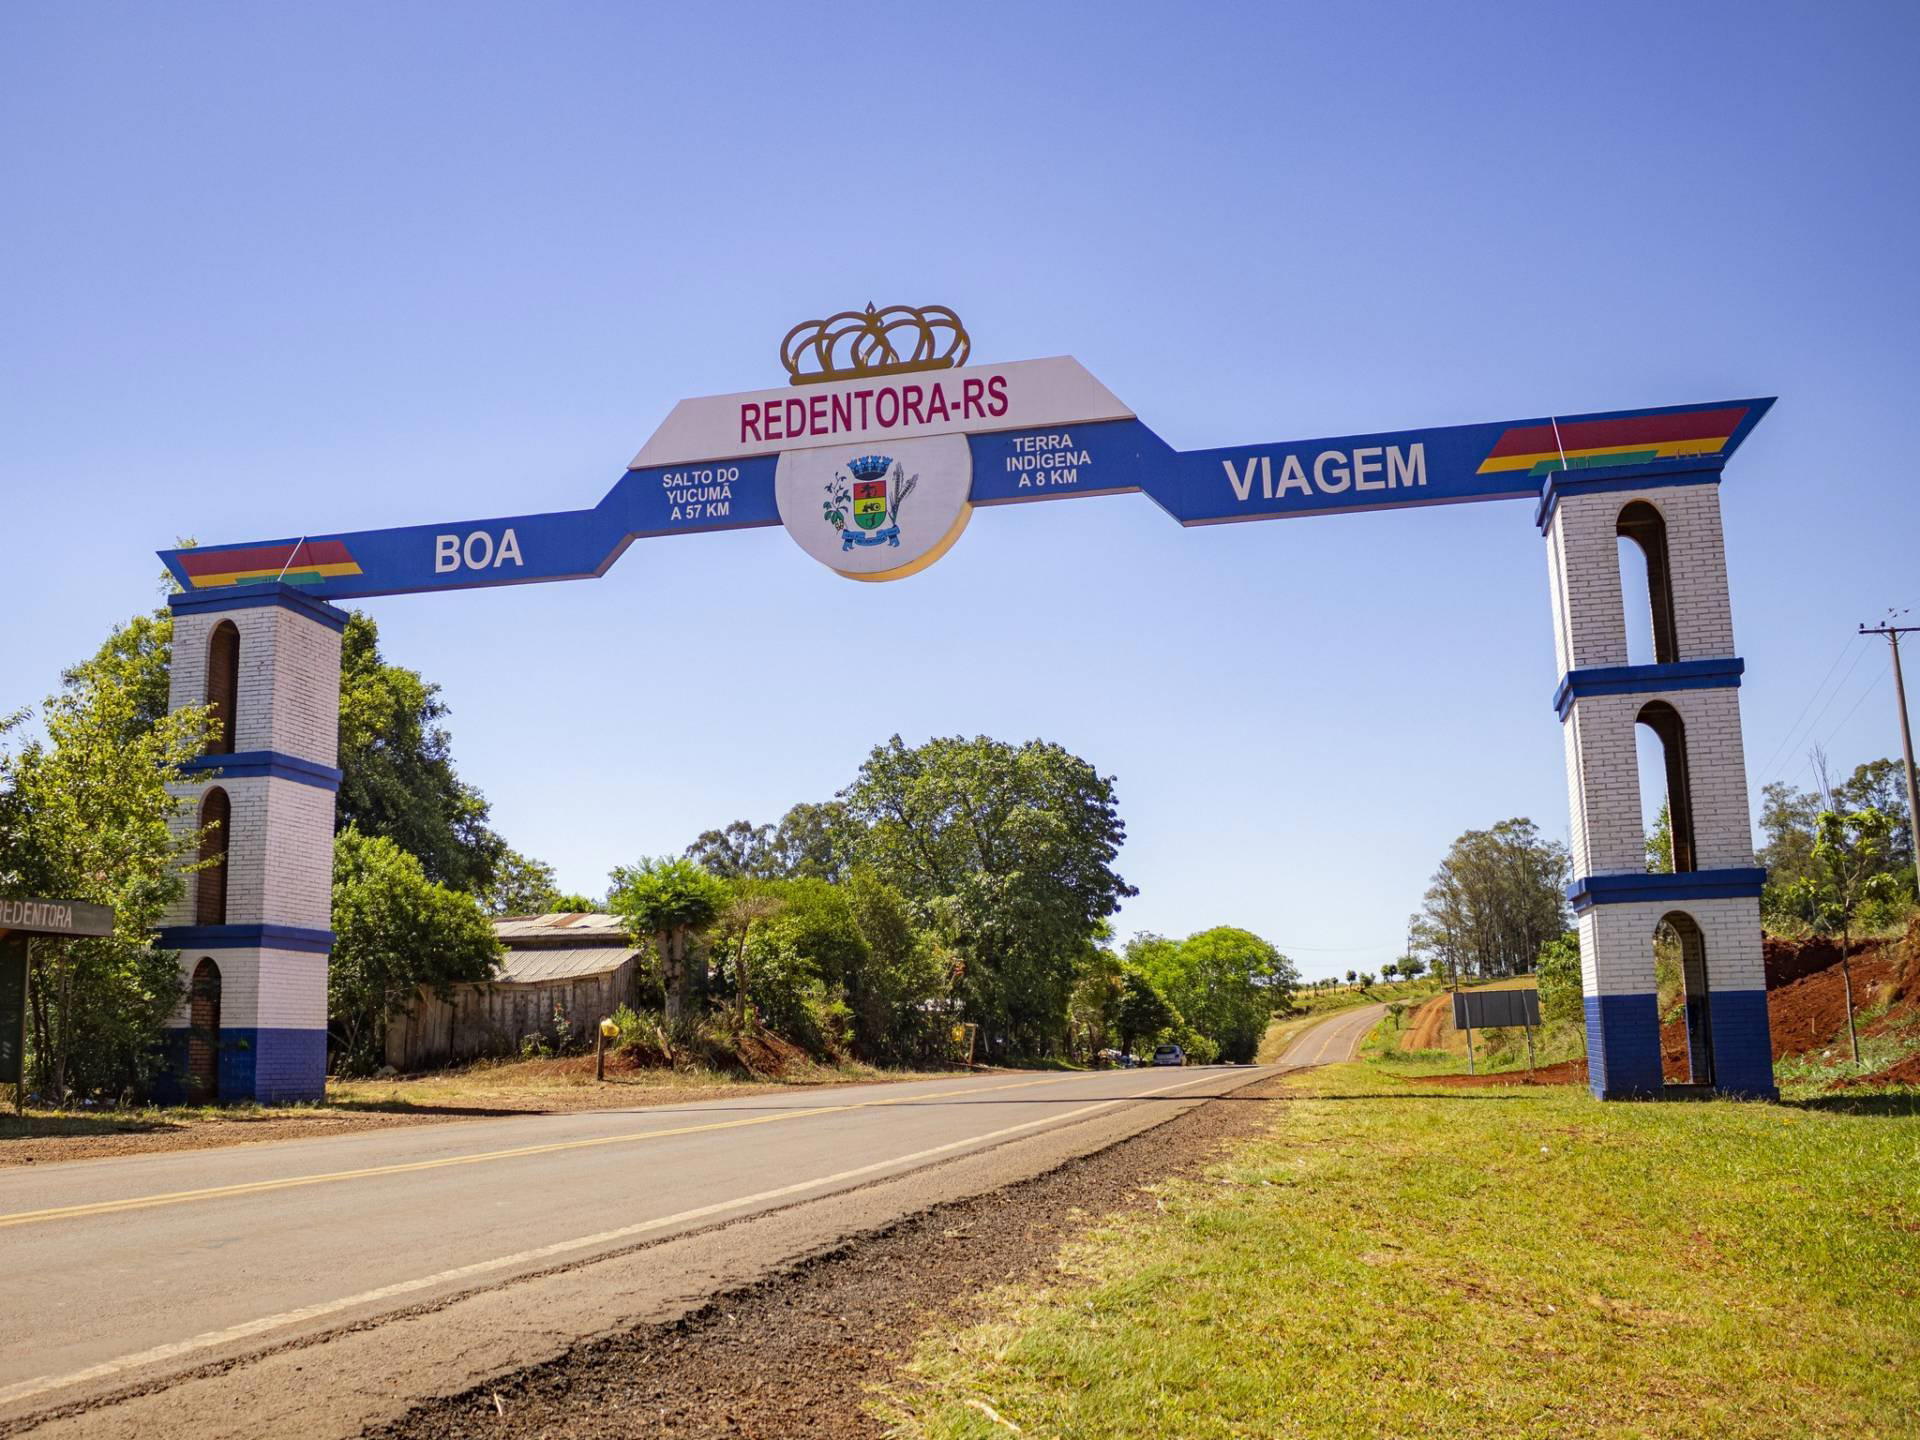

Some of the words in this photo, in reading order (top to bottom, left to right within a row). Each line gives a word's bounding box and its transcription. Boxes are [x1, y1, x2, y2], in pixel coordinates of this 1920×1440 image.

[740, 375, 1009, 444] REDENTORA-RS
[1012, 433, 1073, 453] TERRA
[1006, 450, 1092, 472] INDÍGENA
[1222, 442, 1428, 501] VIAGEM
[662, 470, 713, 488] SALTO
[716, 467, 740, 483] DO
[1018, 472, 1032, 488] A
[1035, 471, 1046, 486] 8
[1050, 468, 1078, 485] KM
[666, 482, 732, 505] YUCUMÃ
[670, 506, 682, 521] A
[685, 504, 703, 520] 57
[706, 501, 730, 518] KM
[435, 528, 524, 574] BOA
